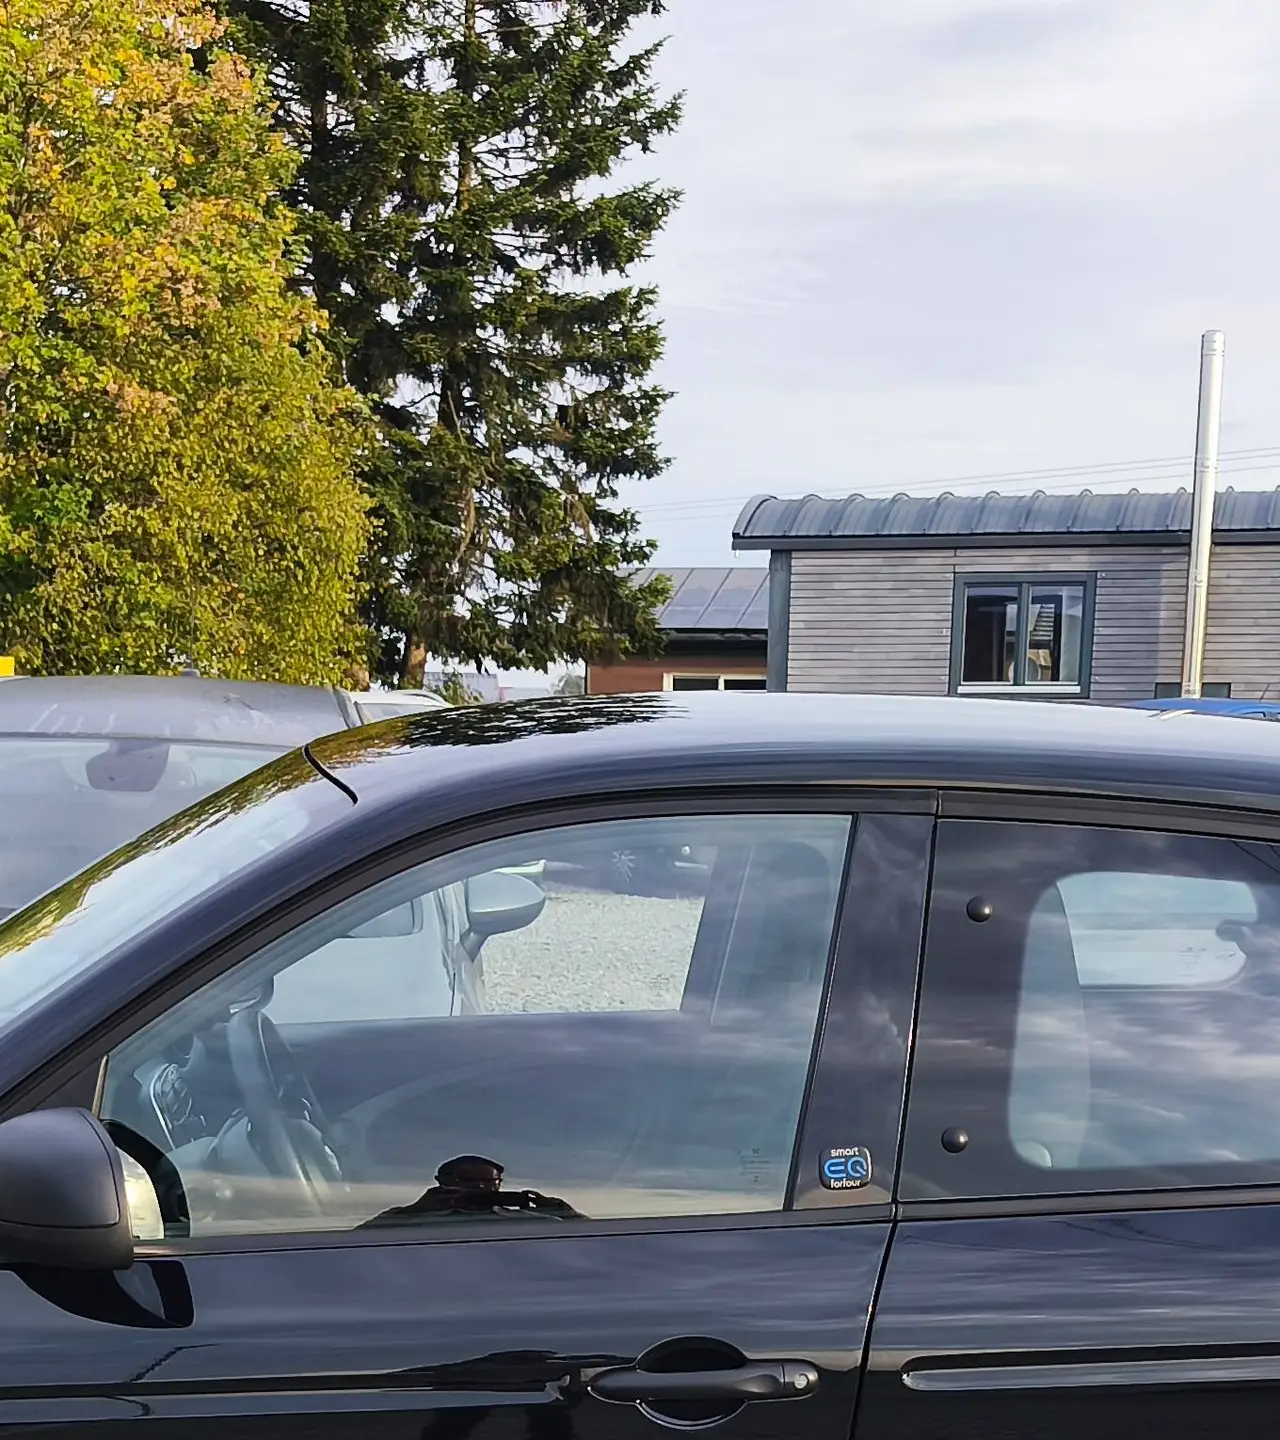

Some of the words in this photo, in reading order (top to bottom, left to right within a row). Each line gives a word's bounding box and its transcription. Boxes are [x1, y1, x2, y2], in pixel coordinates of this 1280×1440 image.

[830, 1147, 859, 1157] smart
[824, 1157, 867, 1178] EQ
[830, 1178, 861, 1189] forfour
